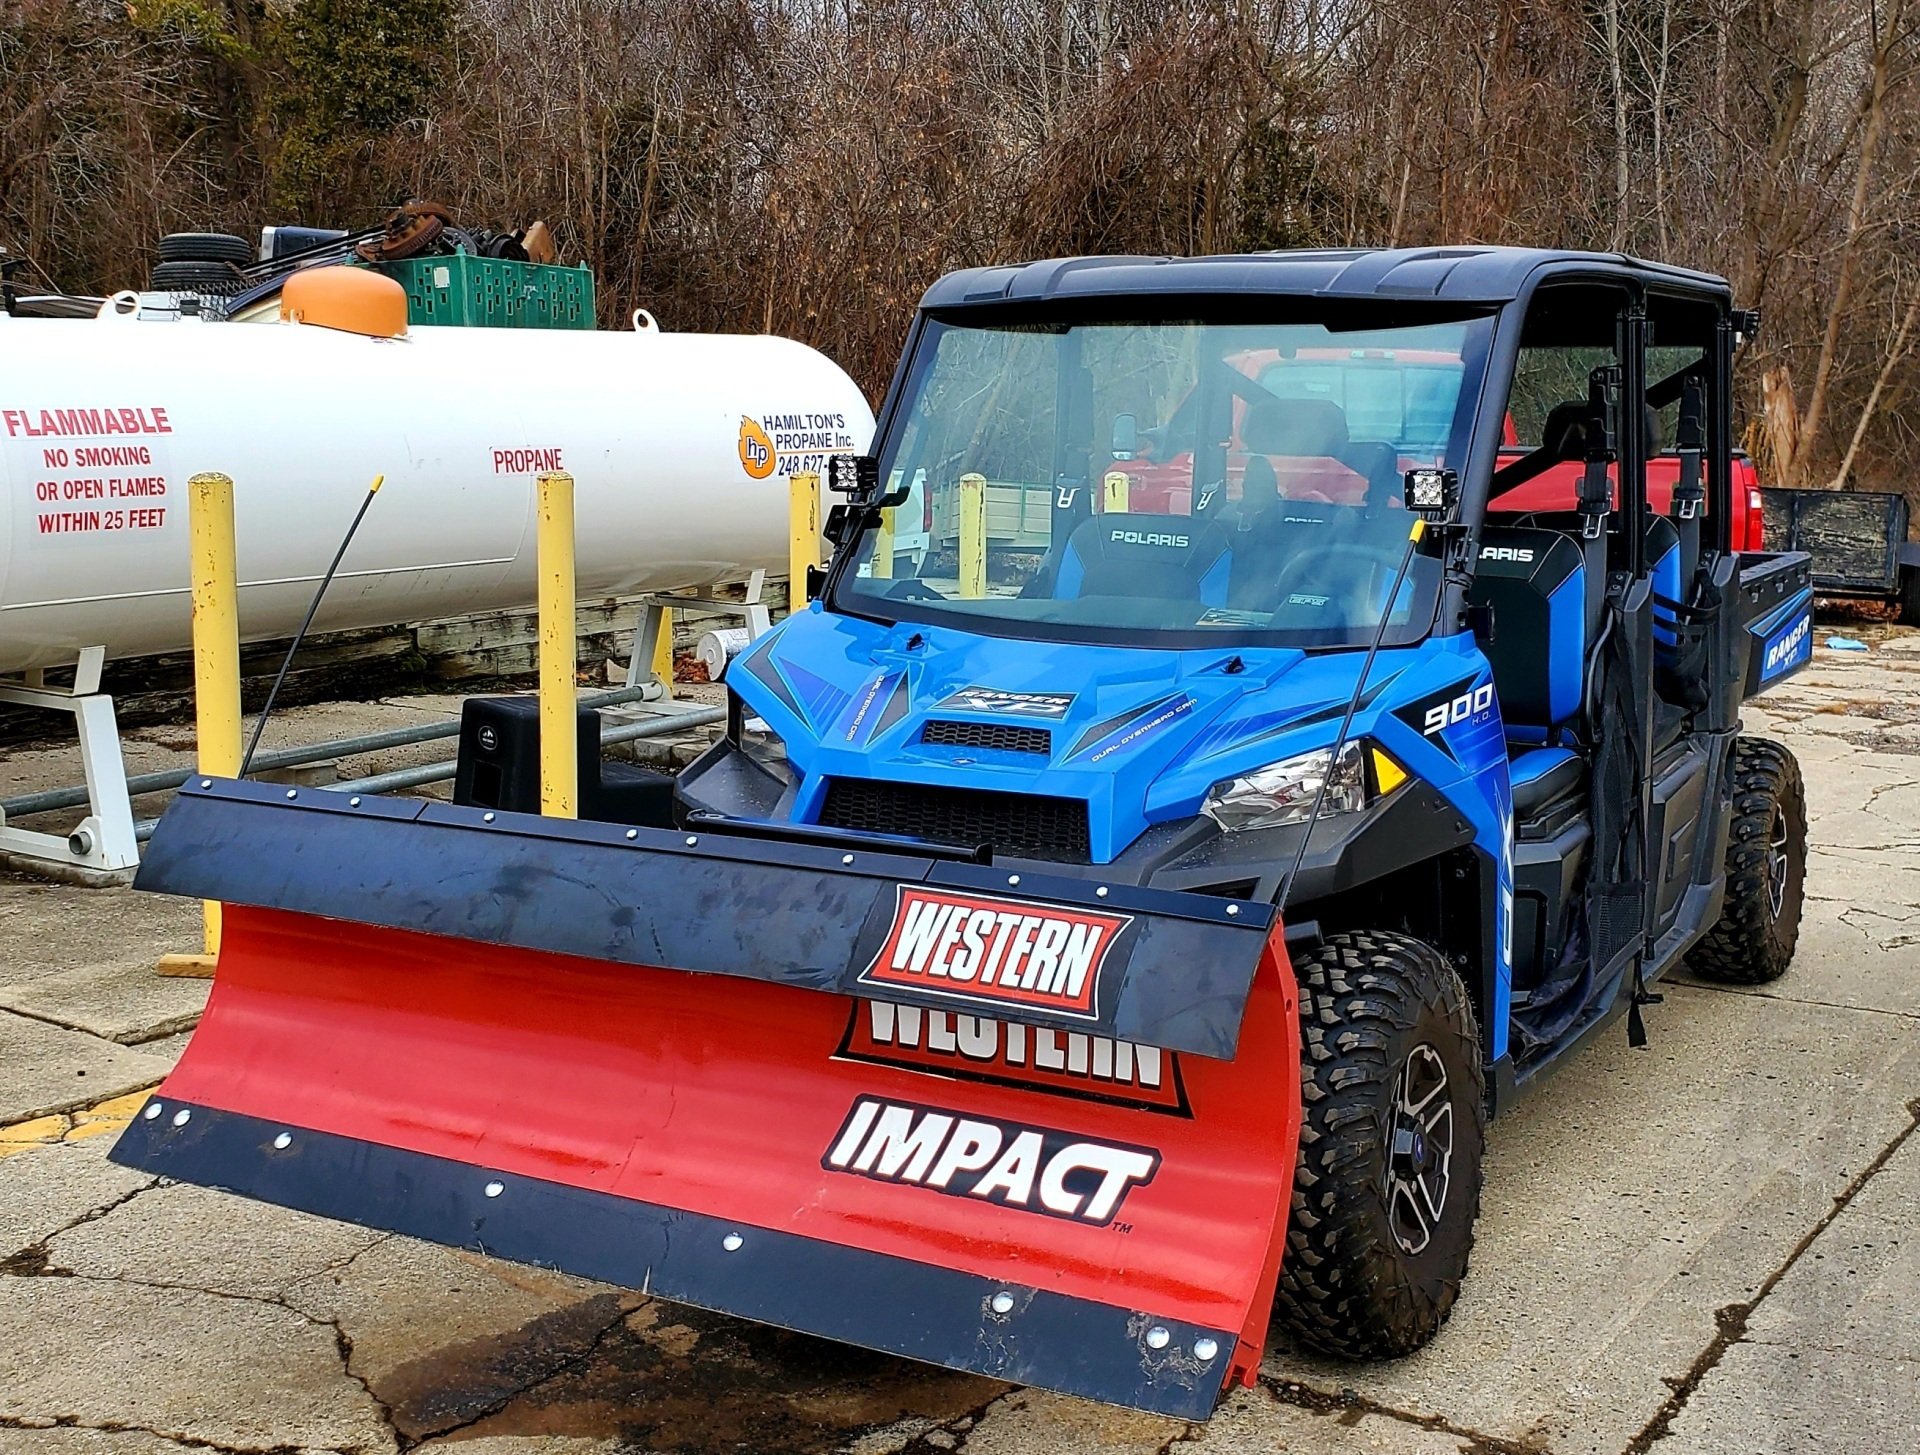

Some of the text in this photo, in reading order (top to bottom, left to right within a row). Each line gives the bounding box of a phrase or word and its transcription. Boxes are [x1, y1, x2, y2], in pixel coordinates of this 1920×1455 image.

[2, 408, 172, 436] FLAMMABLE
[763, 414, 845, 430] HAMILTON'S
[747, 437, 767, 466] hp
[776, 432, 855, 449] PROPANE Inc.
[43, 446, 151, 468] NO SMOKING
[494, 448, 564, 473] PROPANE
[778, 456, 800, 476] 248
[36, 477, 166, 501] OR OPEN FLAMES
[38, 508, 166, 533] WITHIN 25 FEET
[1111, 530, 1189, 547] POLARIS
[1479, 546, 1534, 562] ARIS
[1766, 614, 1810, 670] RANGER
[1782, 646, 1798, 671] XP
[956, 691, 1071, 705] RANGER
[1424, 682, 1493, 736] 900
[1091, 698, 1198, 762] DUAL OVERHEAD CAM
[1472, 711, 1491, 726] H.O.
[889, 899, 1104, 998] WESTERN
[829, 1100, 1155, 1234] IMPACT TM
